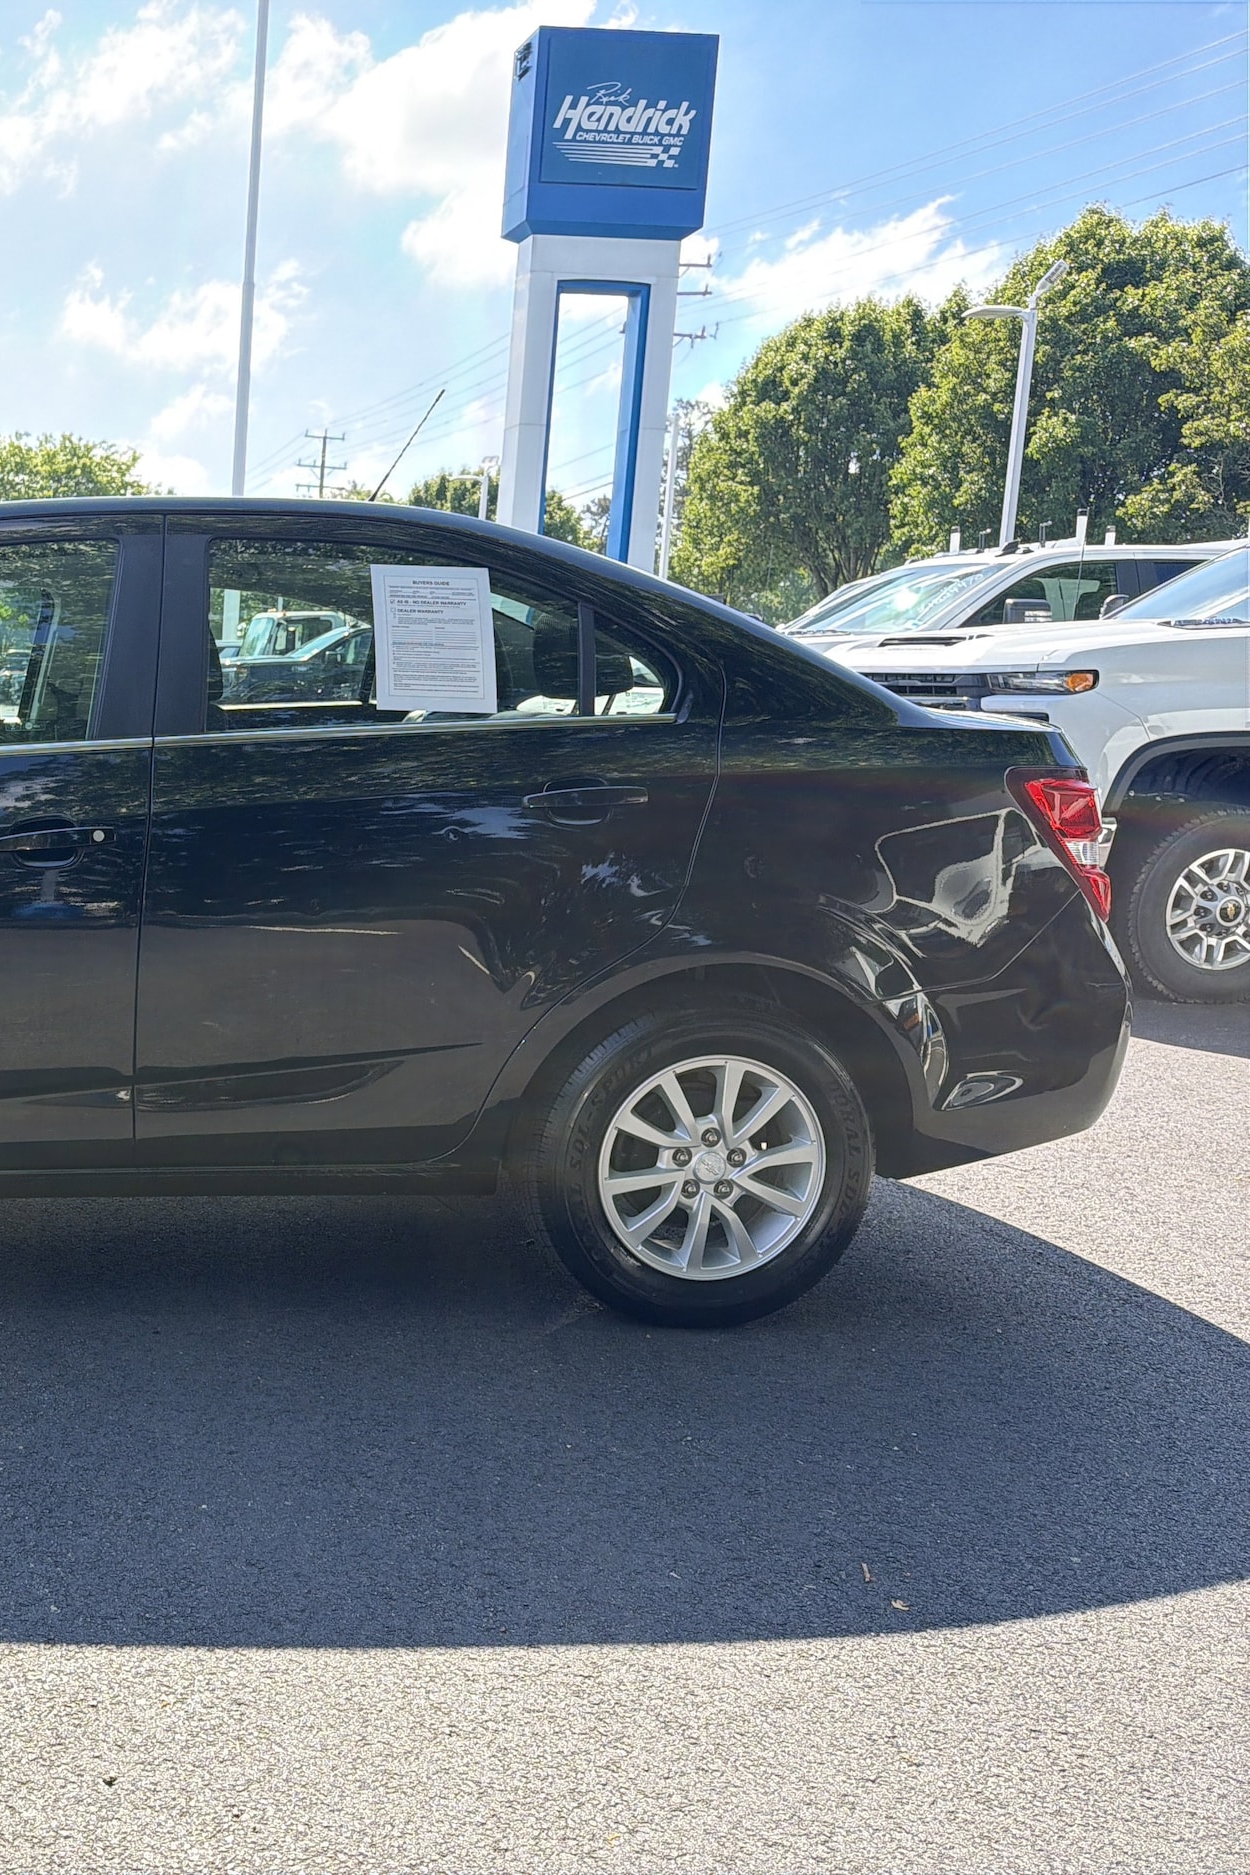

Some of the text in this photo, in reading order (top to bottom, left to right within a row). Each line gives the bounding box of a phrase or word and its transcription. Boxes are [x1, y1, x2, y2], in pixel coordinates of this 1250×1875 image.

[552, 95, 697, 140] Hendrick
[576, 131, 684, 146] CHEVROLET BUICK GMC
